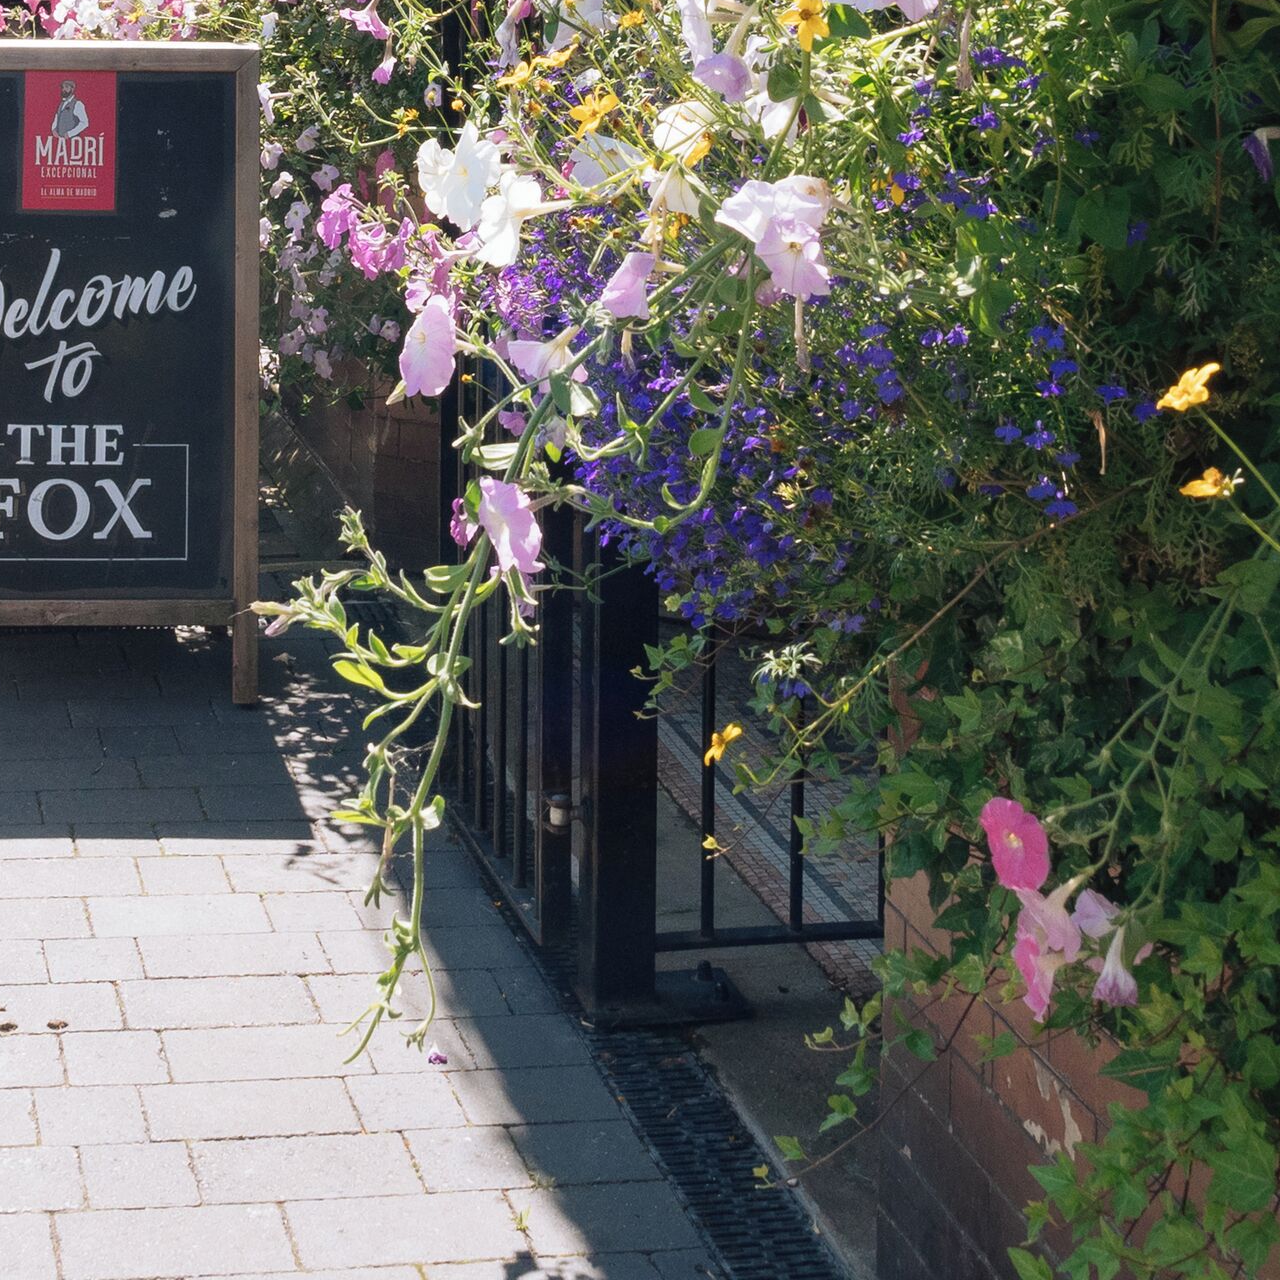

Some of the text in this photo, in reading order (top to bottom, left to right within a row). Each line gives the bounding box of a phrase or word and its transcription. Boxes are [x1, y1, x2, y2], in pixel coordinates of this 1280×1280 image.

[35, 132, 104, 166] MADRÍ
[41, 166, 97, 179] EXCEPCIONAL
[75, 187, 97, 197] MADRID
[7, 423, 125, 466] THE
